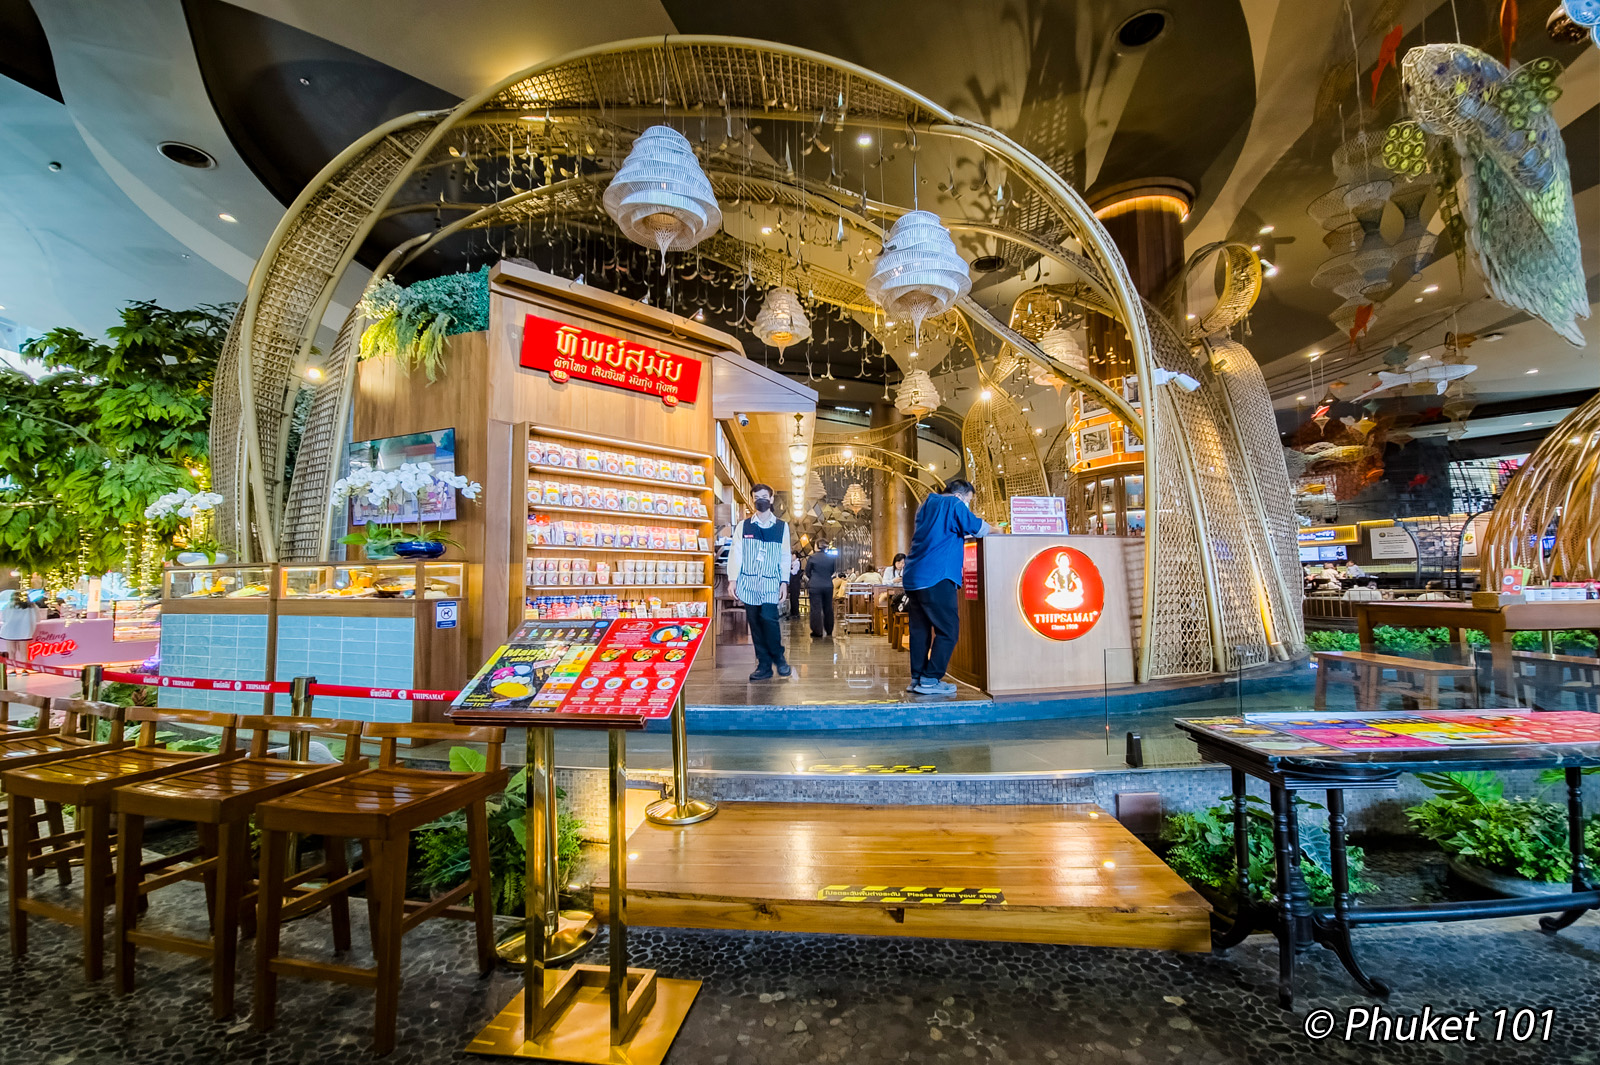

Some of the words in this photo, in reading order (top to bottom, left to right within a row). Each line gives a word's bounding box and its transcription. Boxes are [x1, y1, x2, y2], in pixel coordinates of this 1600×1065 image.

[555, 325, 683, 382] ทิพย์สมัย
[553, 355, 587, 374] ผัดไทย
[1033, 611, 1095, 623] THIPSAMAI
[35, 633, 66, 642] Rolling
[28, 639, 77, 661] Pinn
[412, 692, 445, 701] THIPSAMAI
